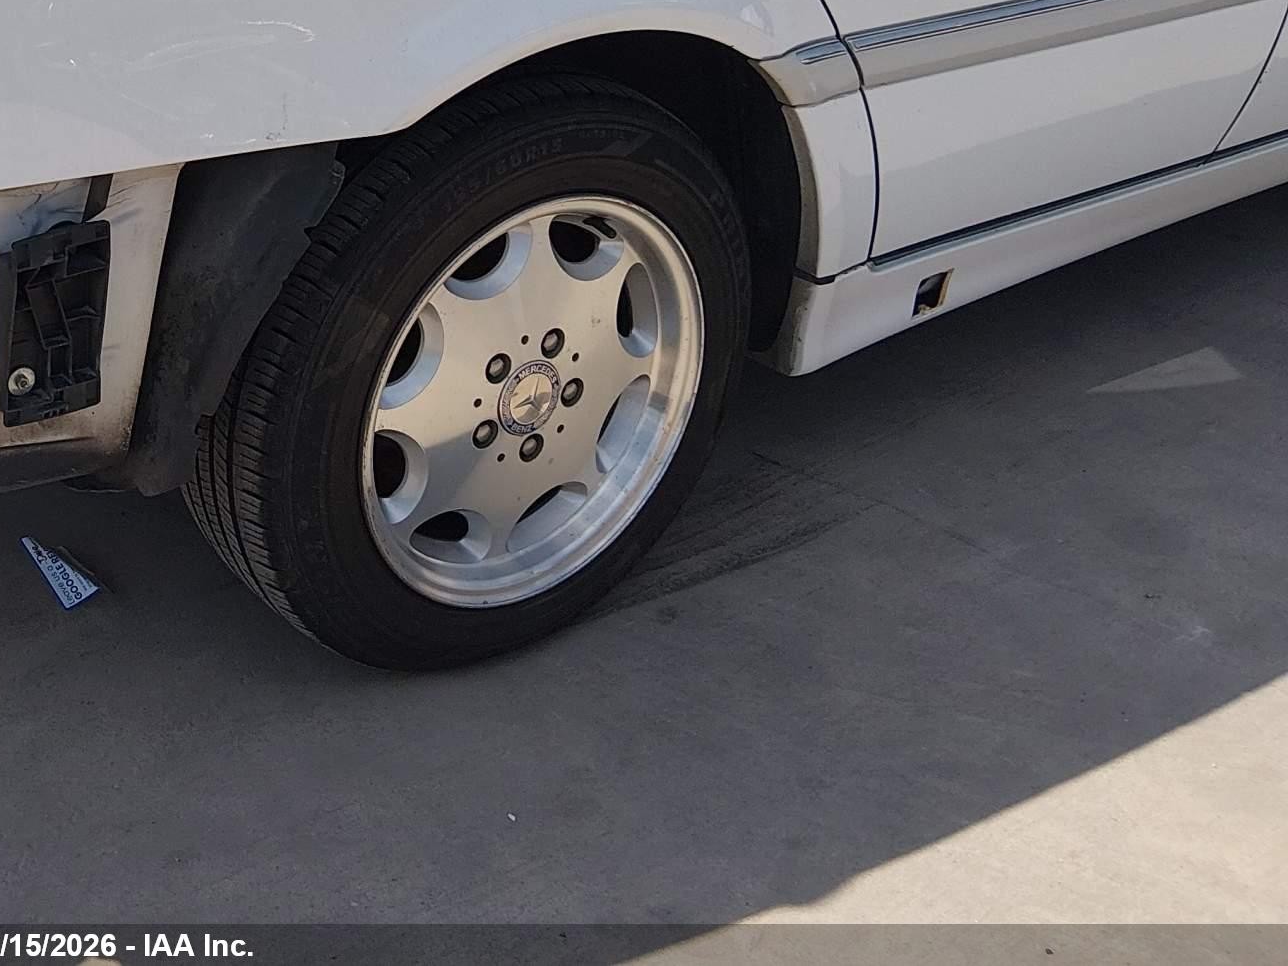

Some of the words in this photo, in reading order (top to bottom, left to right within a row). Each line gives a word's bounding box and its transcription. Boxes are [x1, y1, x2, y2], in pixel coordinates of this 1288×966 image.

[519, 364, 558, 385] MERCEDES
[511, 423, 534, 433] BENZ
[55, 563, 83, 600] GOOGLE
